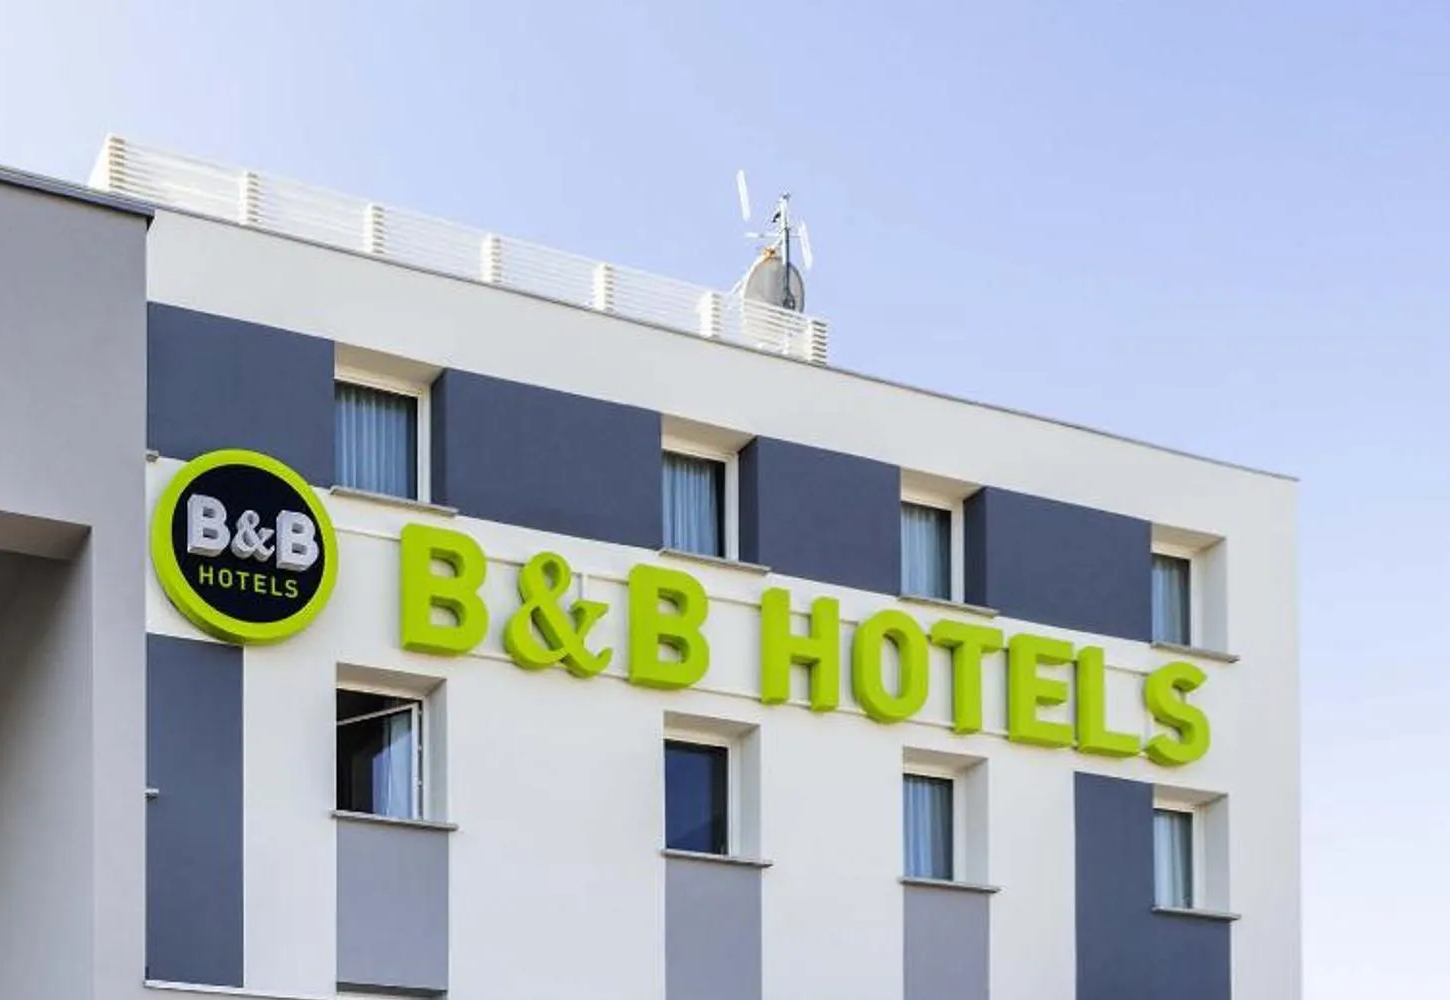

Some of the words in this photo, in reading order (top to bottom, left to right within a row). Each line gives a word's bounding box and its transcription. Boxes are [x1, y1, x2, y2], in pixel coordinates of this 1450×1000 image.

[187, 494, 319, 572] B&B
[199, 565, 299, 599] HOTELS
[400, 523, 710, 690] B&B
[760, 587, 1211, 765] HOTELS
